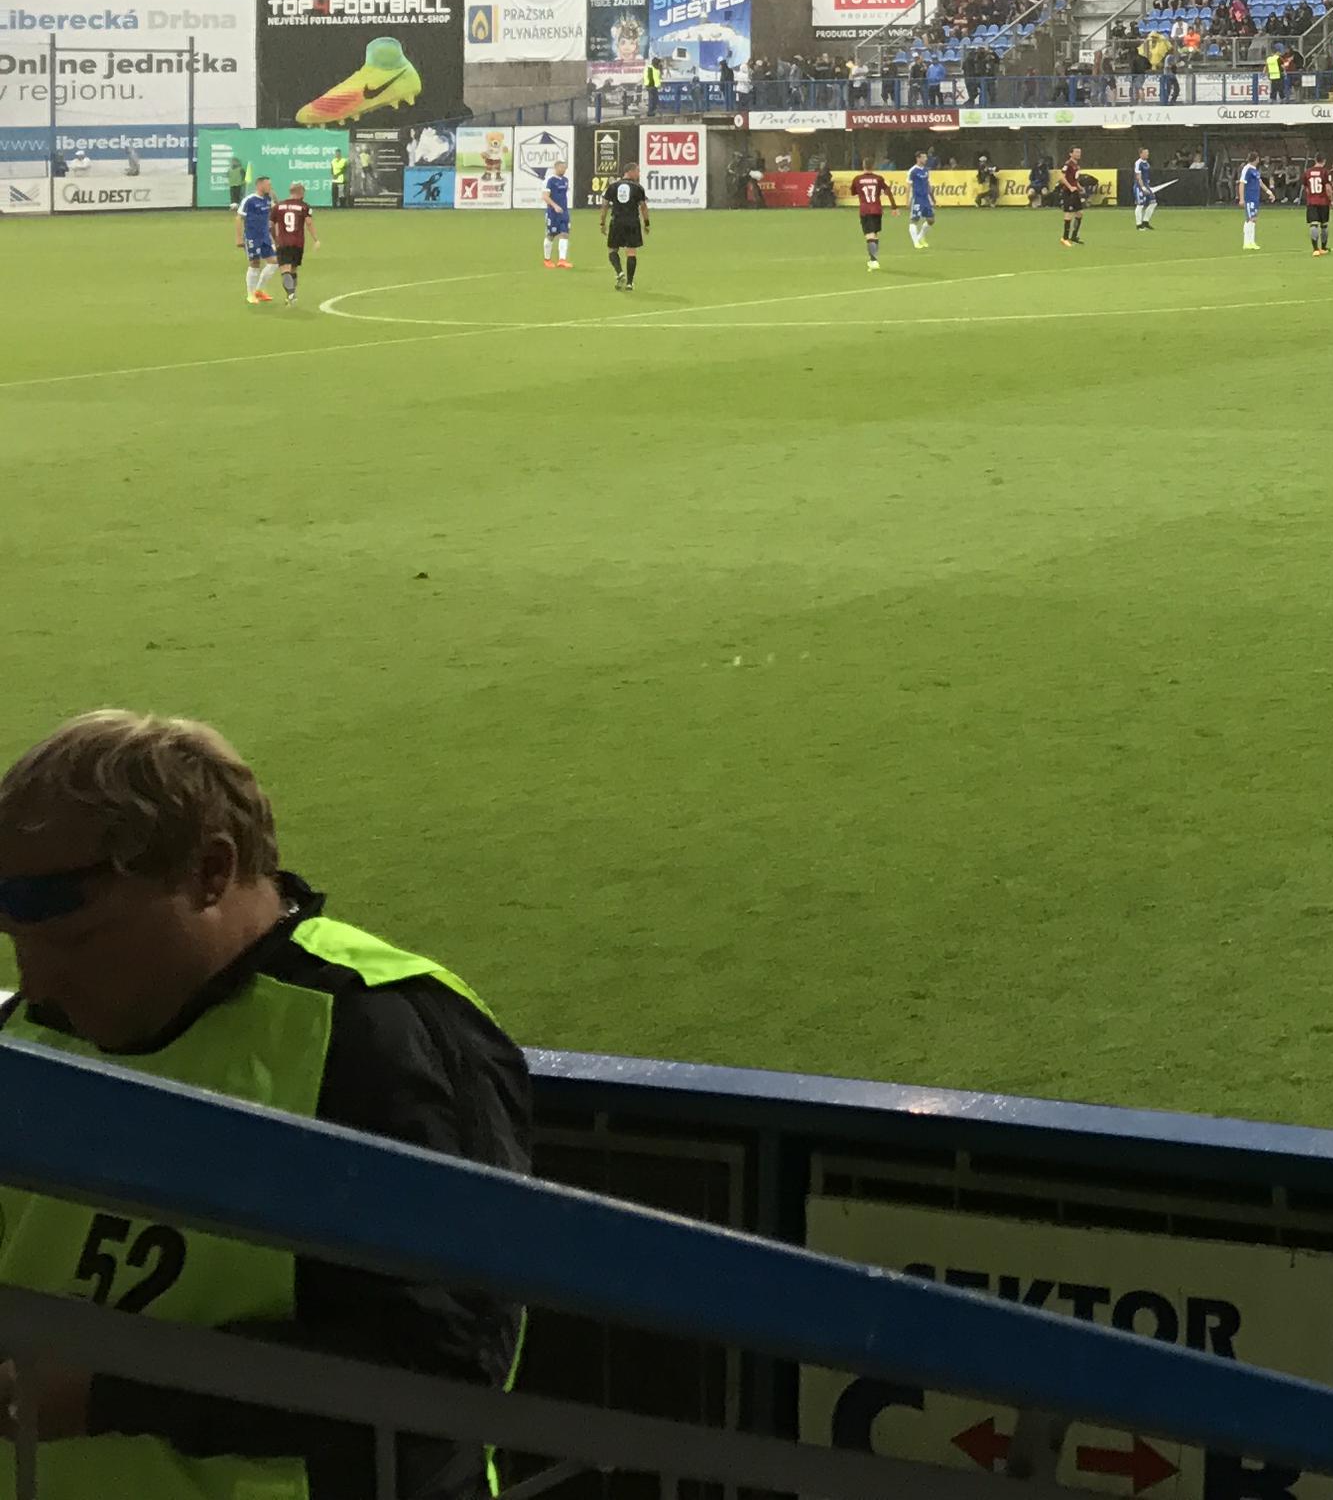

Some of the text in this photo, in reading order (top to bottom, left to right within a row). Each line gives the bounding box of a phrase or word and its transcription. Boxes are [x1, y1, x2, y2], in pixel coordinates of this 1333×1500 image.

[147, 9, 237, 30] Drbna
[310, 13, 359, 25] FOTBALOVÁ
[410, 14, 416, 24] A
[418, 14, 451, 24] E-SHOP
[0, 50, 239, 80] Onlne jednička
[19, 80, 143, 106] regionu.
[852, 113, 953, 125] VINOTÉKA U KRYŠOTA
[526, 148, 559, 165] crytur
[649, 134, 696, 160] živé
[647, 171, 699, 195] firmy
[1308, 177, 1323, 194] 16
[71, 190, 96, 204] ALL
[98, 189, 132, 204] DEST
[861, 185, 877, 203] 17
[284, 211, 296, 232] 9
[74, 1212, 187, 1314] 52
